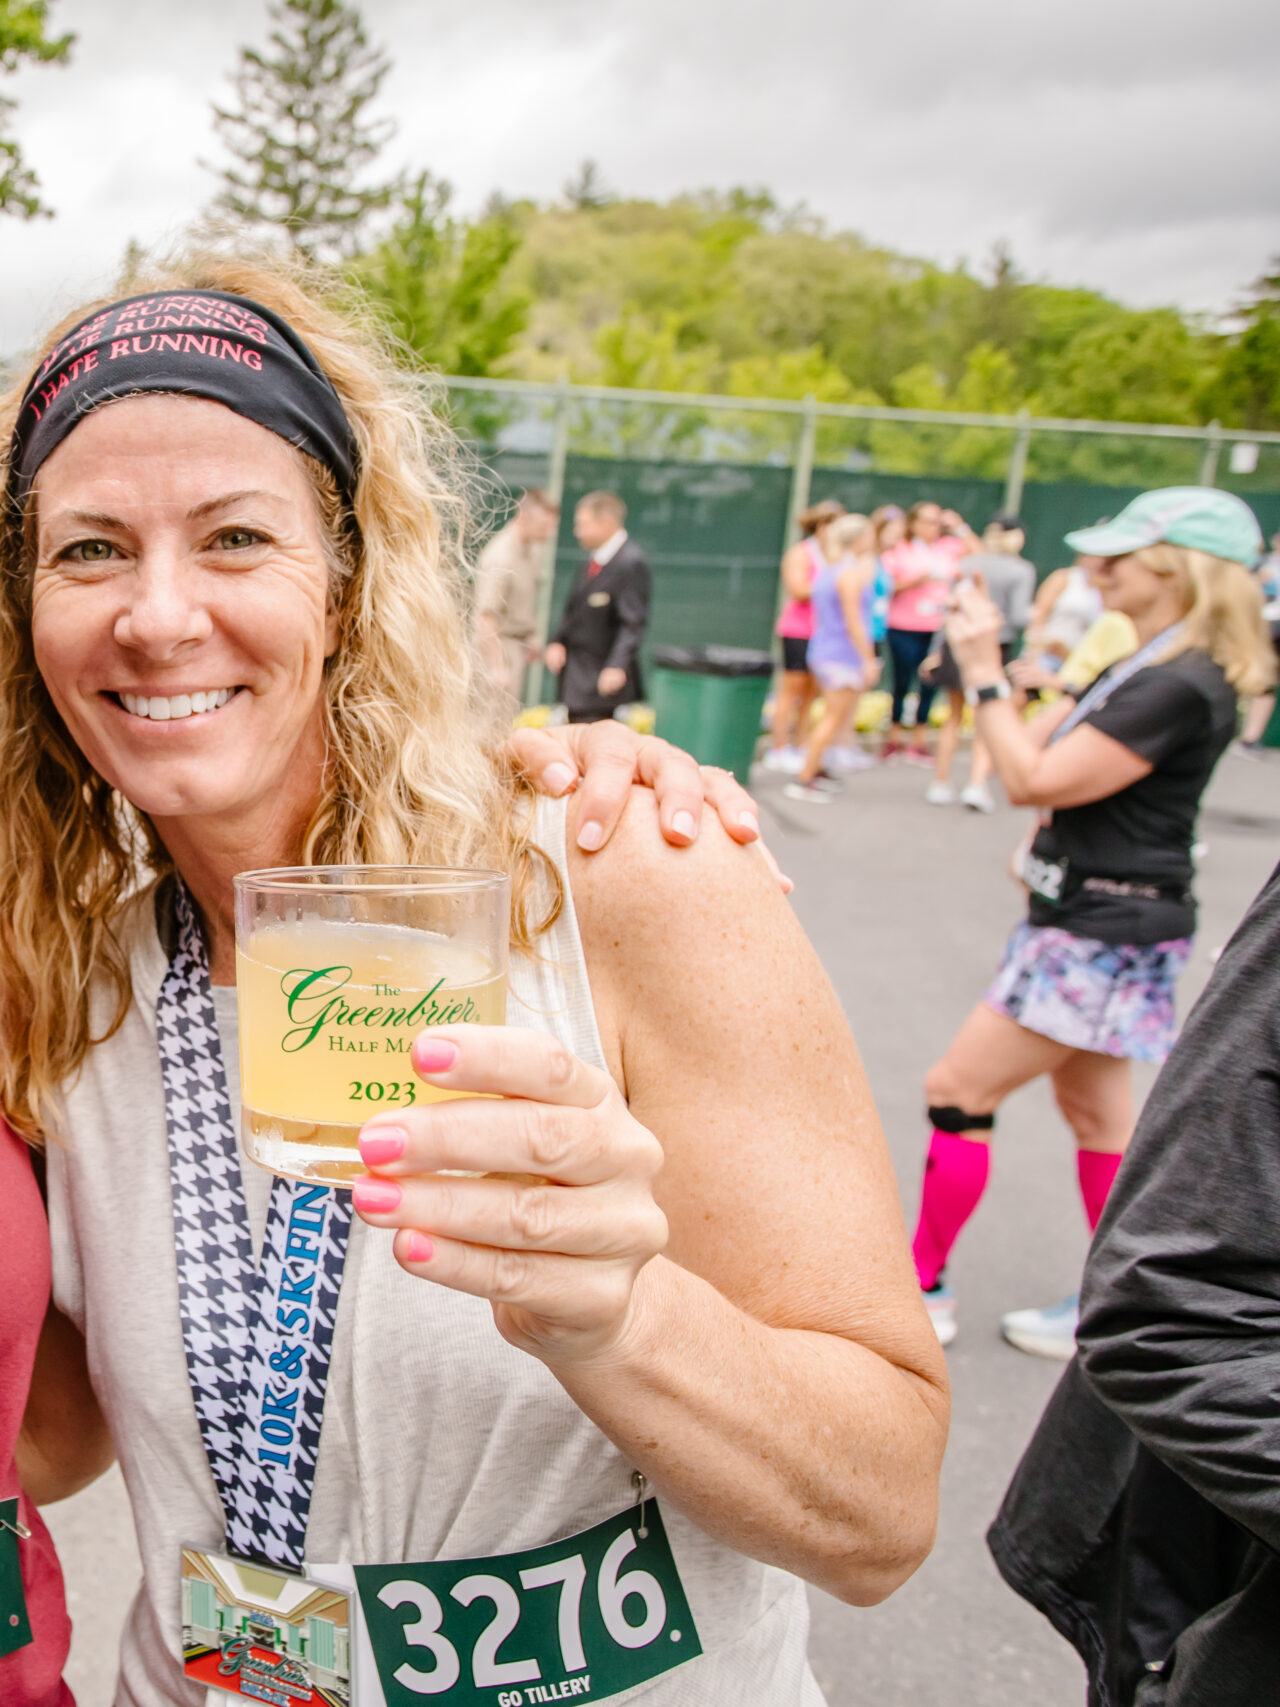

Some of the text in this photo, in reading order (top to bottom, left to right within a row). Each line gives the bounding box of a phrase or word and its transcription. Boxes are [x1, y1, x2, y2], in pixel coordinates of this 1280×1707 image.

[113, 313, 233, 336] RUNNI
[29, 402, 42, 421] I
[40, 349, 99, 408] HATE
[109, 333, 263, 371] RUNNING
[280, 965, 476, 1053] Greenbrier
[372, 984, 401, 997] The
[349, 1080, 417, 1108] 2023
[277, 1267, 316, 1336] 5K
[269, 1340, 306, 1380] &
[258, 1383, 299, 1470] 10K
[376, 1527, 667, 1695] 3276
[498, 1675, 591, 1707] GO TILLERY
